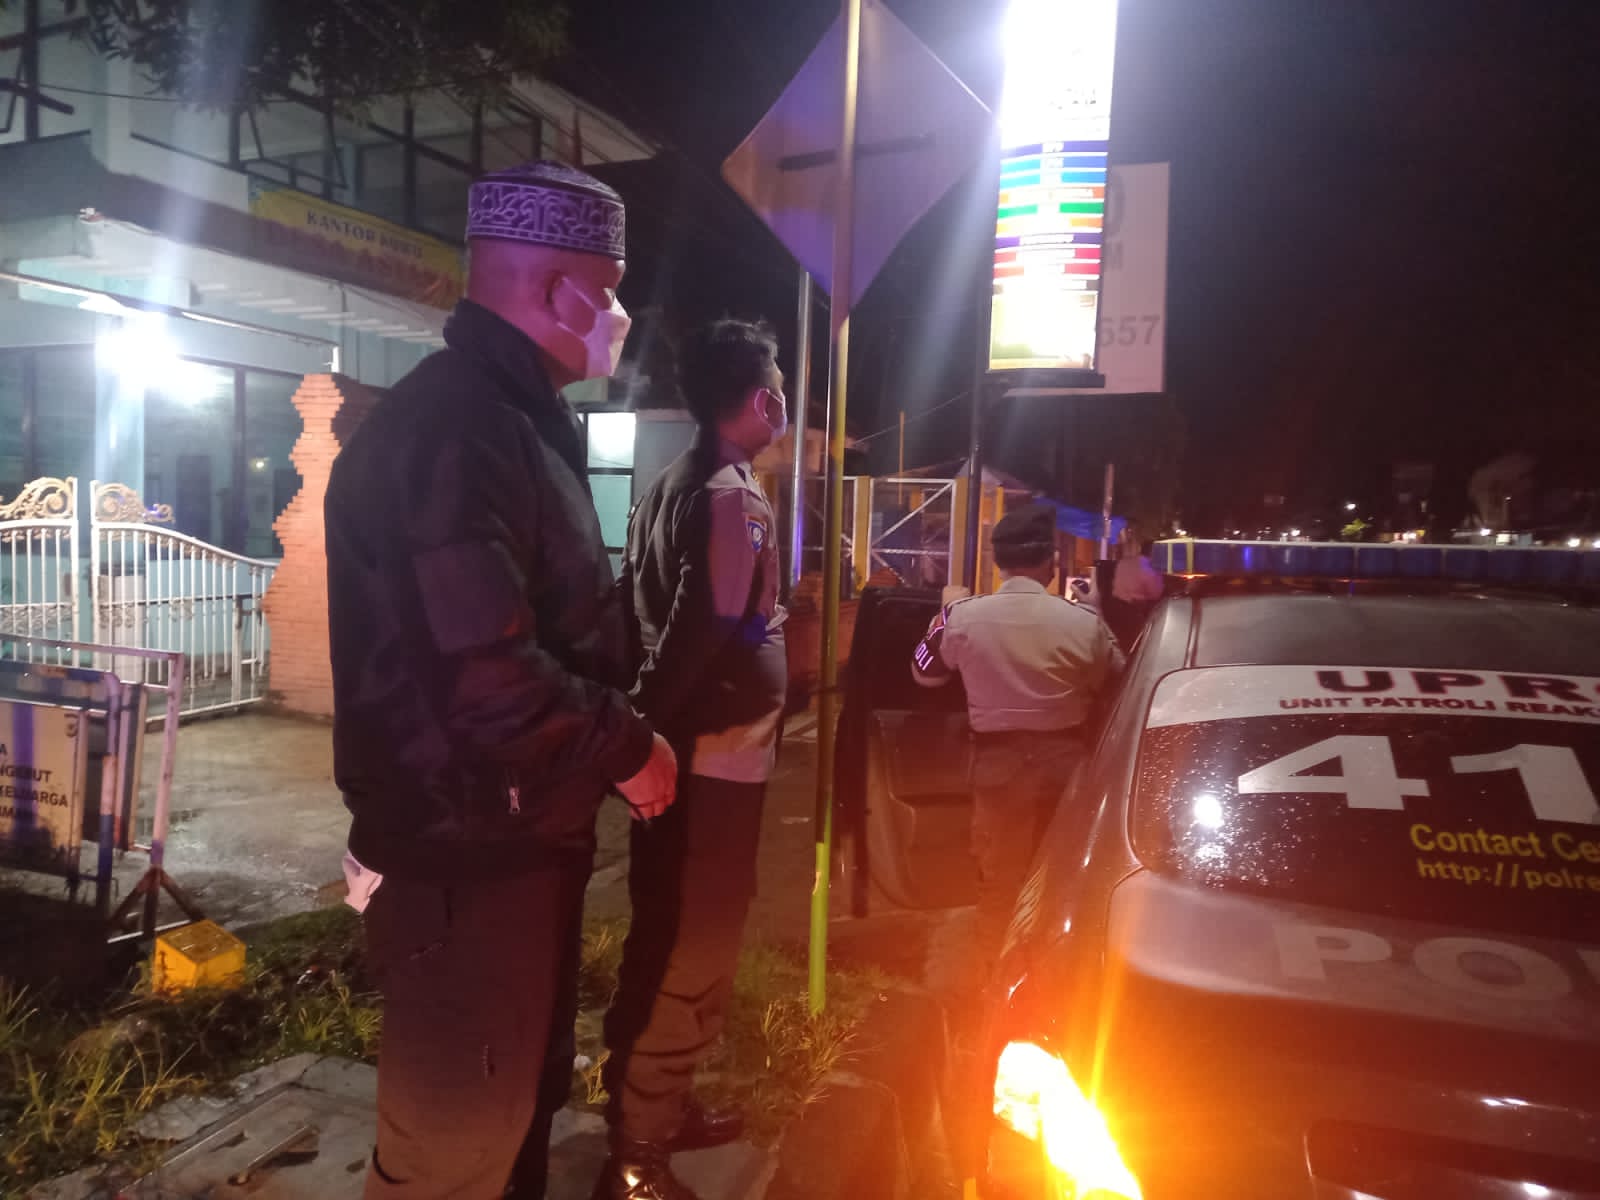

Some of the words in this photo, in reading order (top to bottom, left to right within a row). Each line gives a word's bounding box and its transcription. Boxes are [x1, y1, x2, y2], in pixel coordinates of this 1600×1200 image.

[306, 211, 376, 242] KANTOR
[914, 640, 934, 671] OLI
[1316, 670, 1600, 703] UPR
[1279, 697, 1353, 710] UNIT
[1362, 697, 1497, 711] PATROLI
[1409, 823, 1545, 859] Contact
[1271, 923, 1600, 1002] PO
